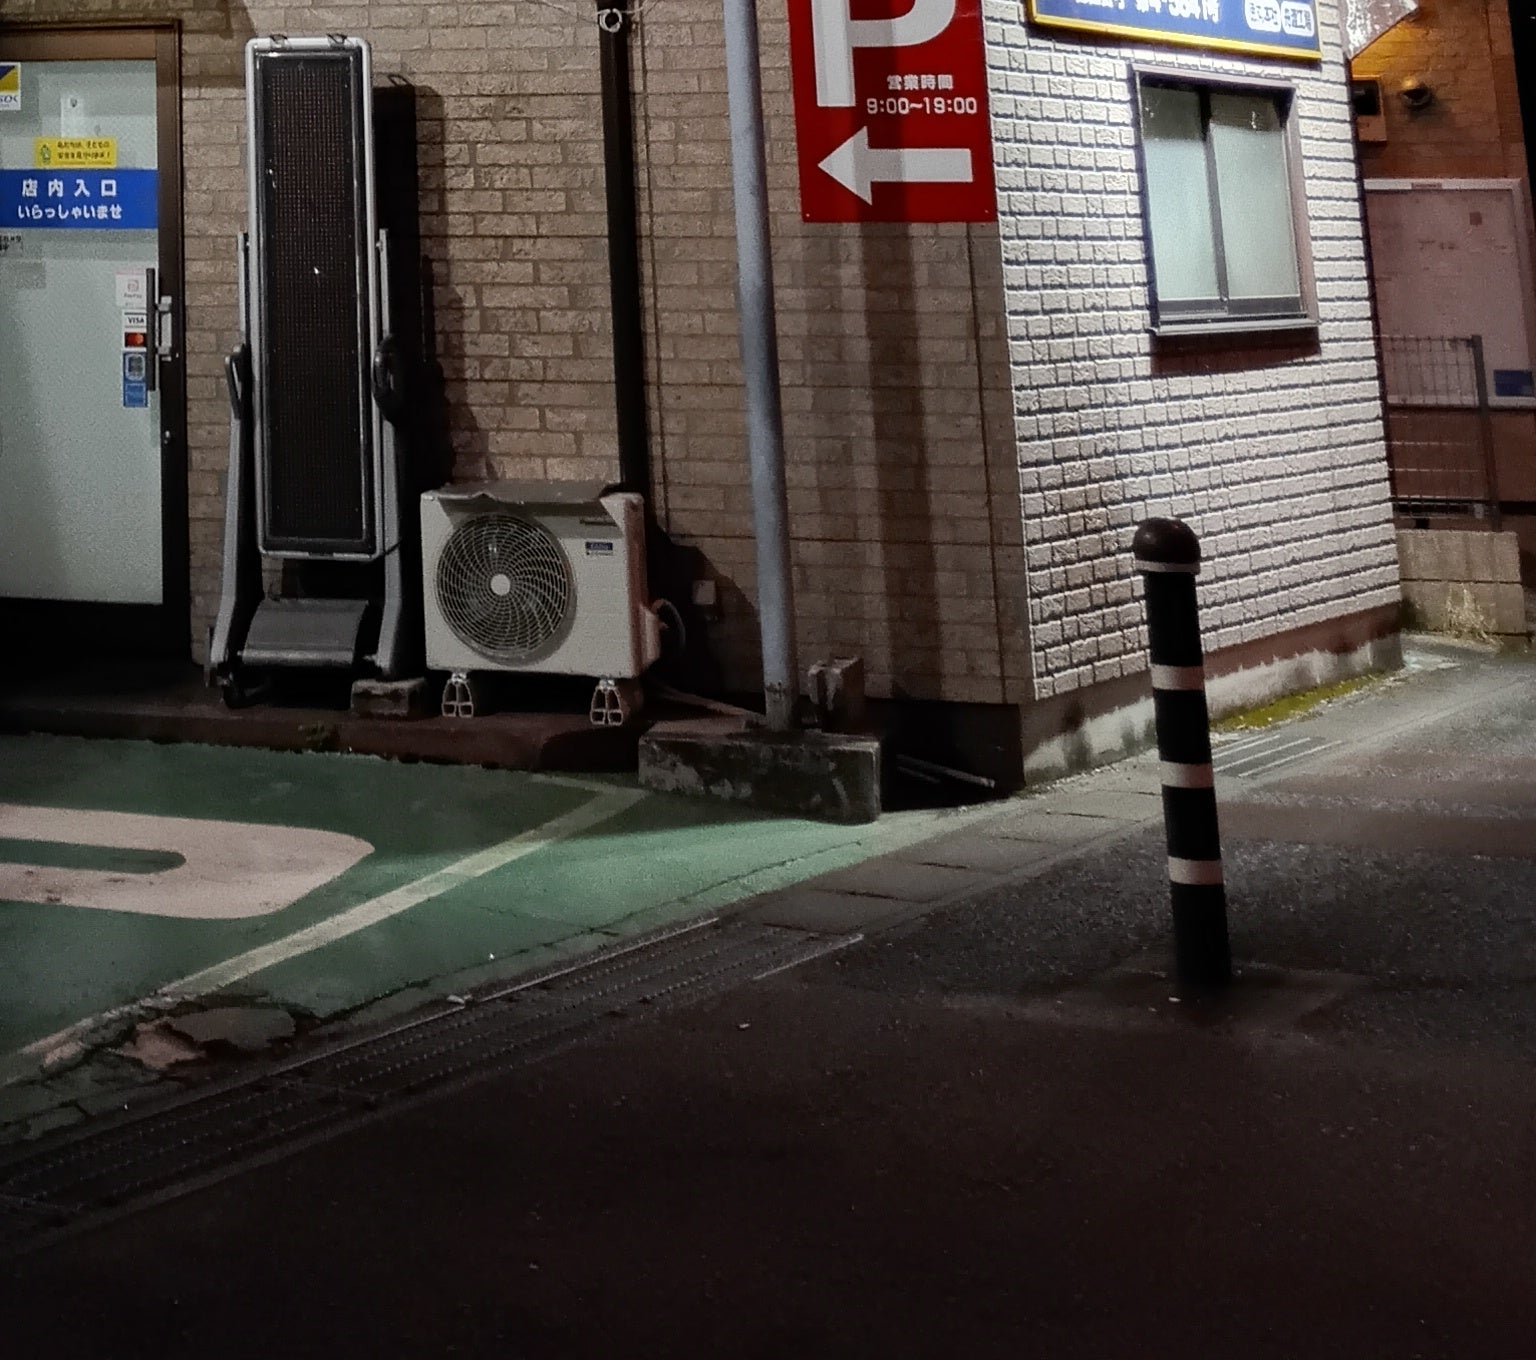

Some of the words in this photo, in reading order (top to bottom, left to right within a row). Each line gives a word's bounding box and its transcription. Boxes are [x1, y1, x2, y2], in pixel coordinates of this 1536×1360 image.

[886, 74, 955, 91] 営業時間
[21, 178, 118, 197] 店内入口
[17, 204, 123, 220] いらっしゃいませ
